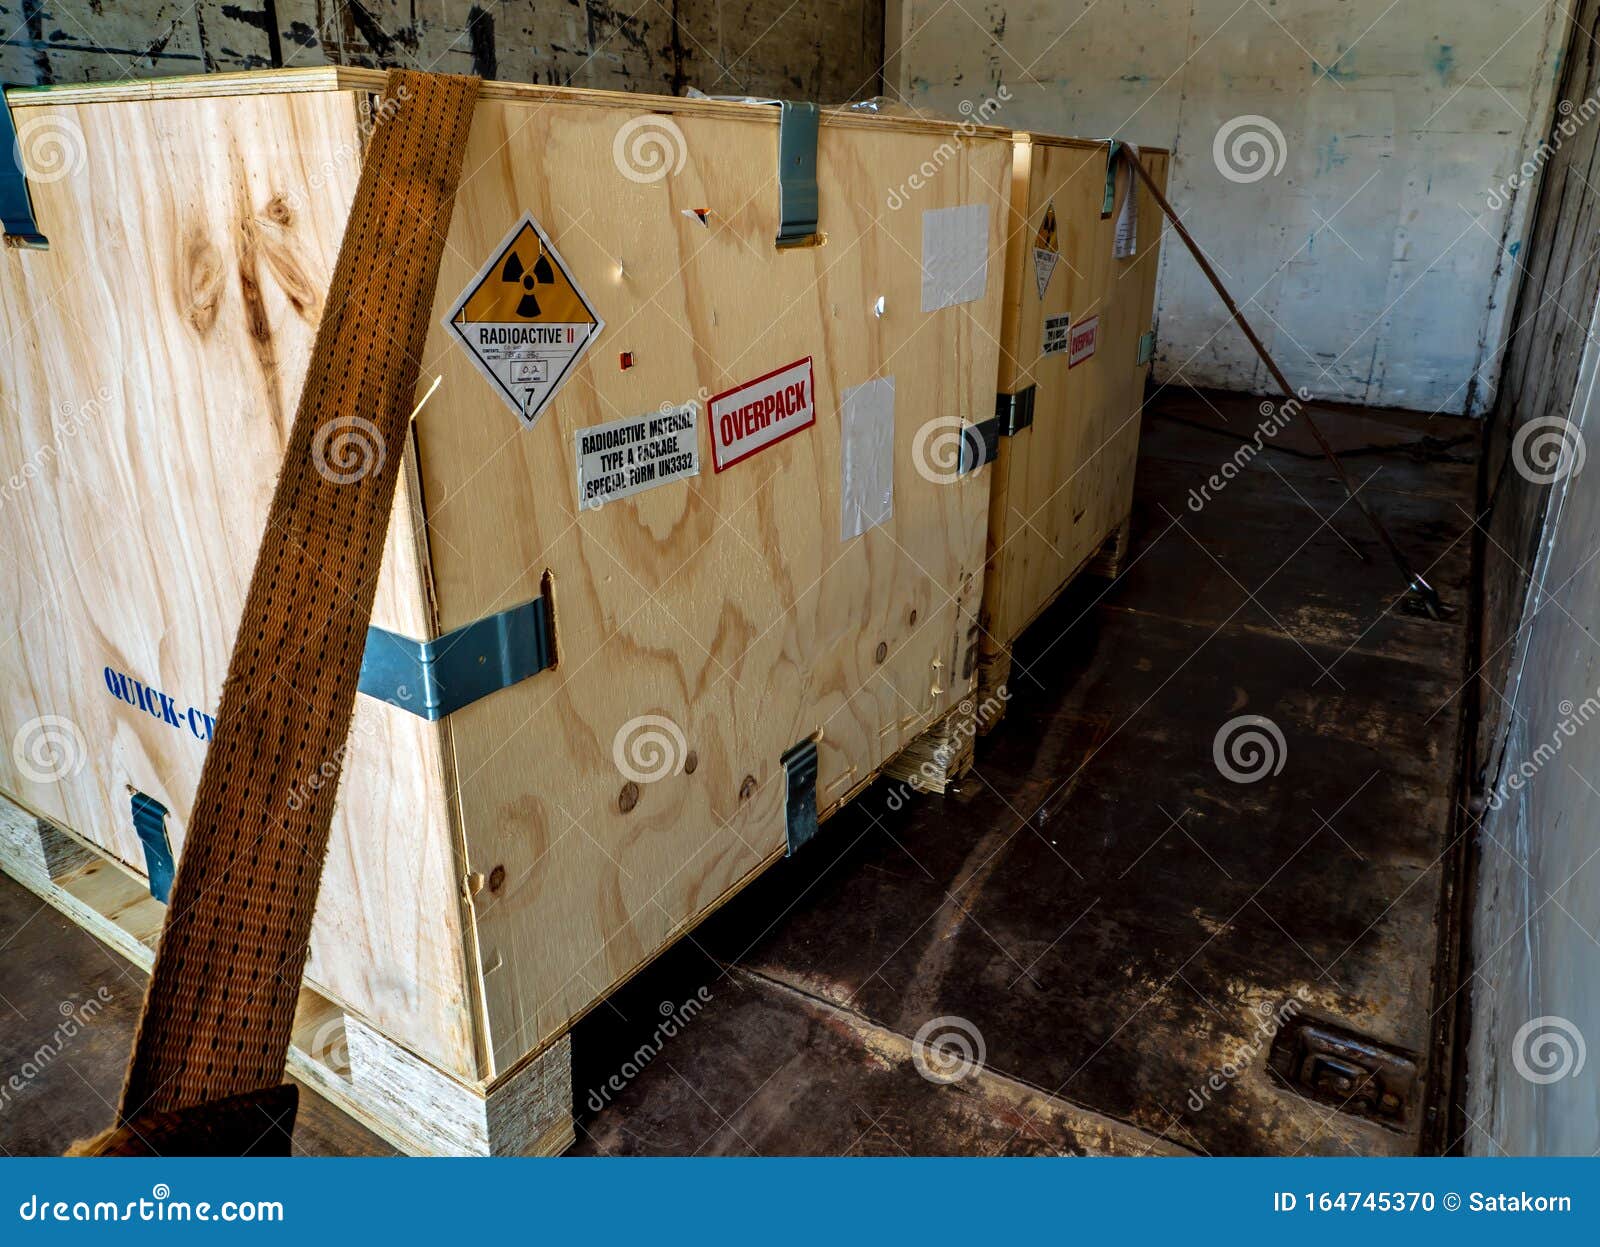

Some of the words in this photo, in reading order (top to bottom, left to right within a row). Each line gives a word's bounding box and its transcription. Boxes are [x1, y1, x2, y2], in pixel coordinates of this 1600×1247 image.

[480, 328, 562, 344] RADIOACTIVE
[567, 328, 574, 343] II
[525, 388, 535, 406] 7
[720, 380, 806, 447] OVERPACK
[582, 423, 646, 455] RADIOACTIVE
[649, 411, 693, 438] MATERIAL
[586, 473, 627, 499] SPECIAL
[629, 463, 655, 487] FORM
[658, 452, 693, 478] UN3332
[600, 450, 624, 473] TYPE
[627, 448, 634, 465] A
